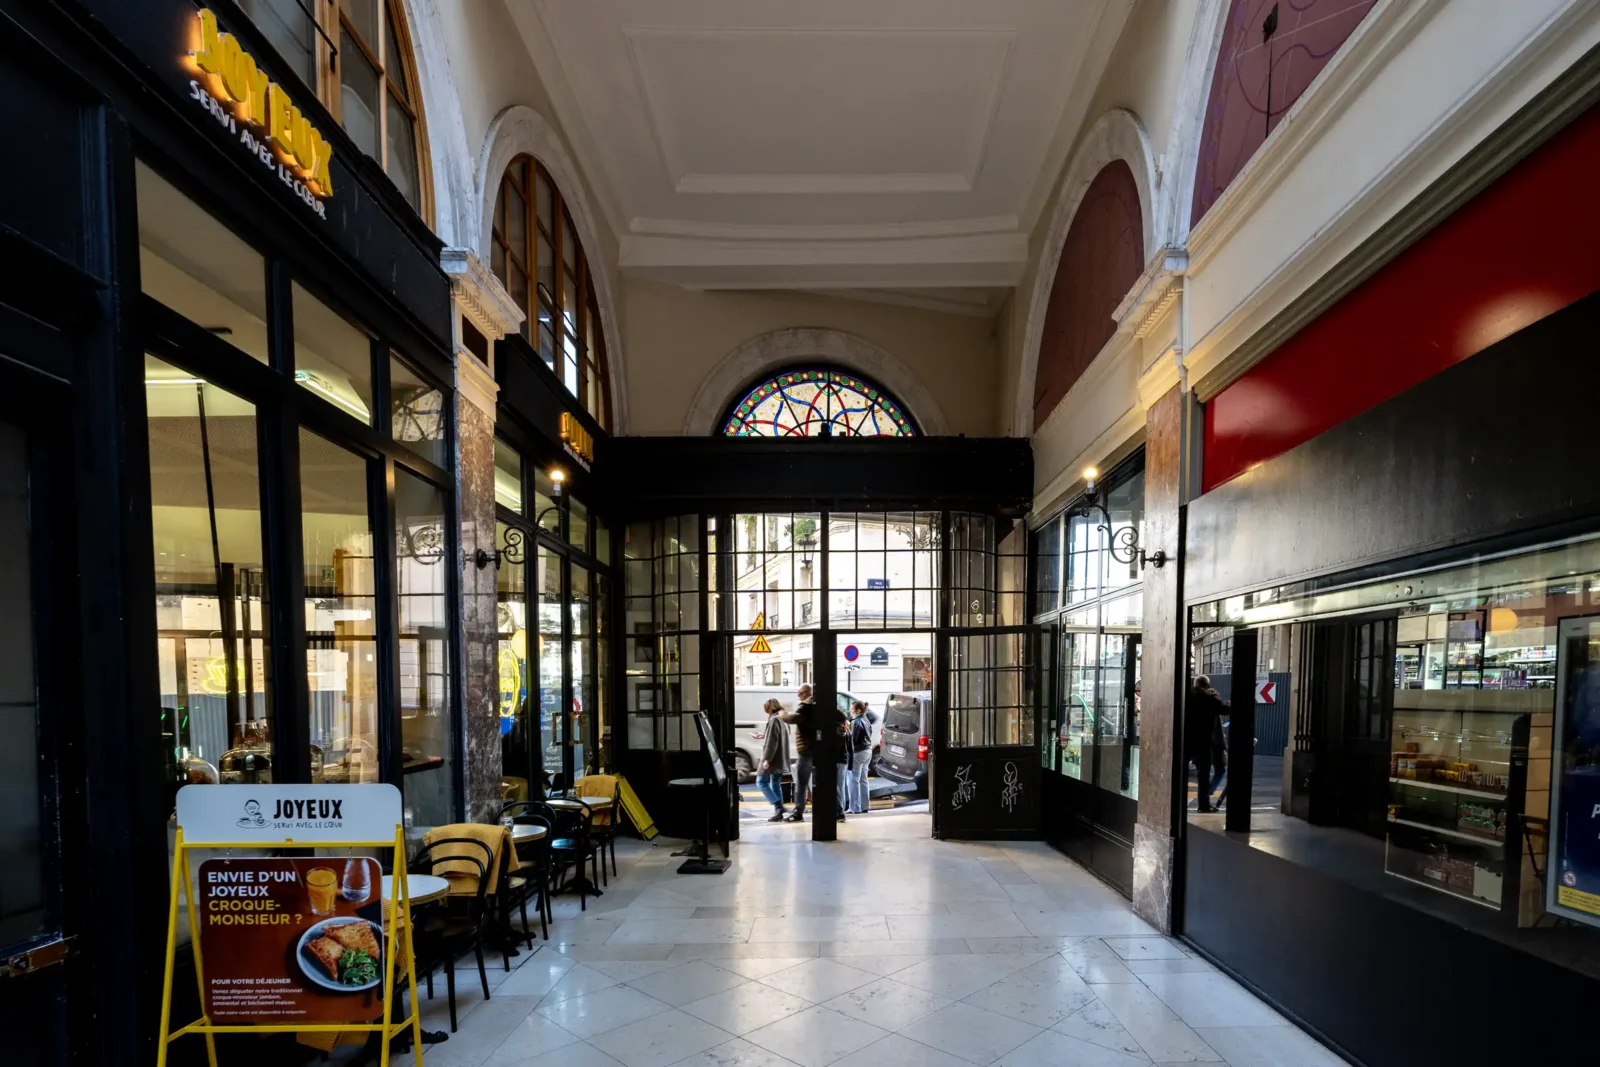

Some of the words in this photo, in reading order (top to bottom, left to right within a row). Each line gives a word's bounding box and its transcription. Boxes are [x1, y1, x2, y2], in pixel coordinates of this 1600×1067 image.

[190, 80, 237, 134] SERVI
[240, 129, 275, 170] AVEC
[278, 164, 293, 188] LE
[273, 799, 343, 819] JOYEUX
[208, 871, 254, 883] ENVIE
[208, 885, 269, 897] JOYEUX
[209, 899, 281, 912] CROQUE-
[209, 914, 290, 925] MONSIEUR
[294, 914, 303, 925] ?
